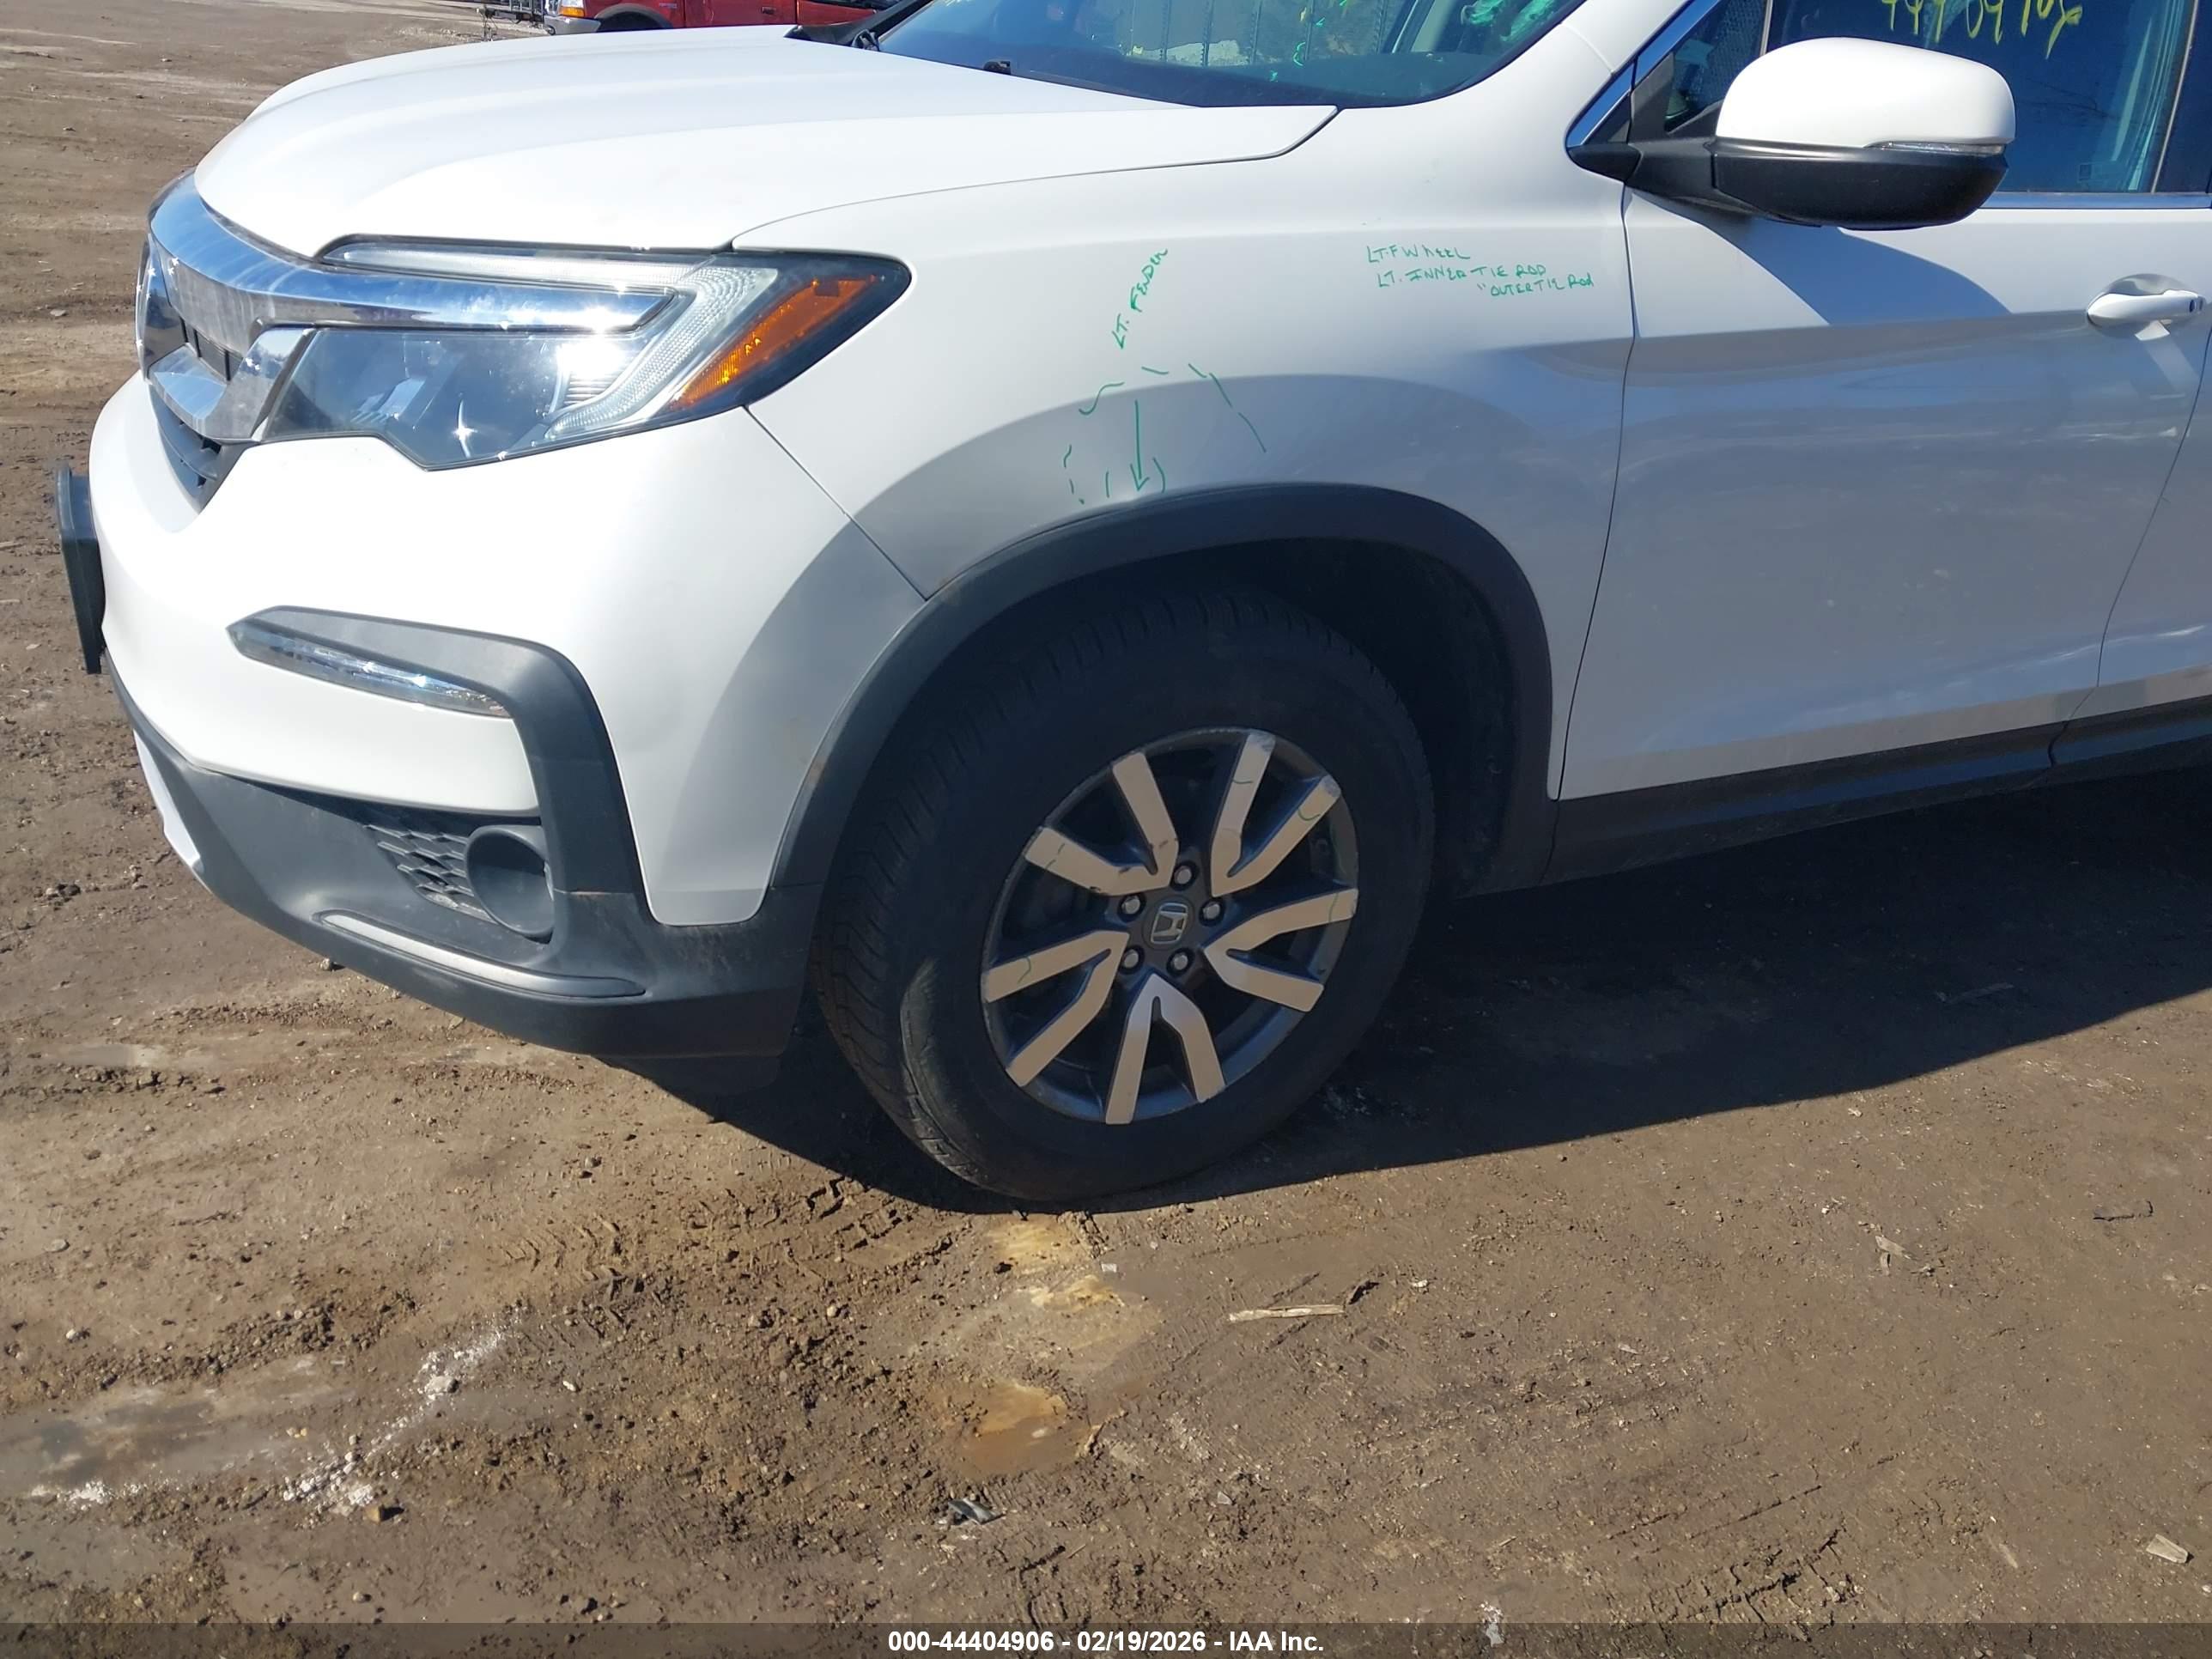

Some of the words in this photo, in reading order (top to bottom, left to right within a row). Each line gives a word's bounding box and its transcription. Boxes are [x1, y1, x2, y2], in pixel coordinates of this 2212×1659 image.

[1405, 265, 1468, 282] INNER
[1470, 265, 1509, 277] TIE
[1516, 264, 1547, 278] ROD
